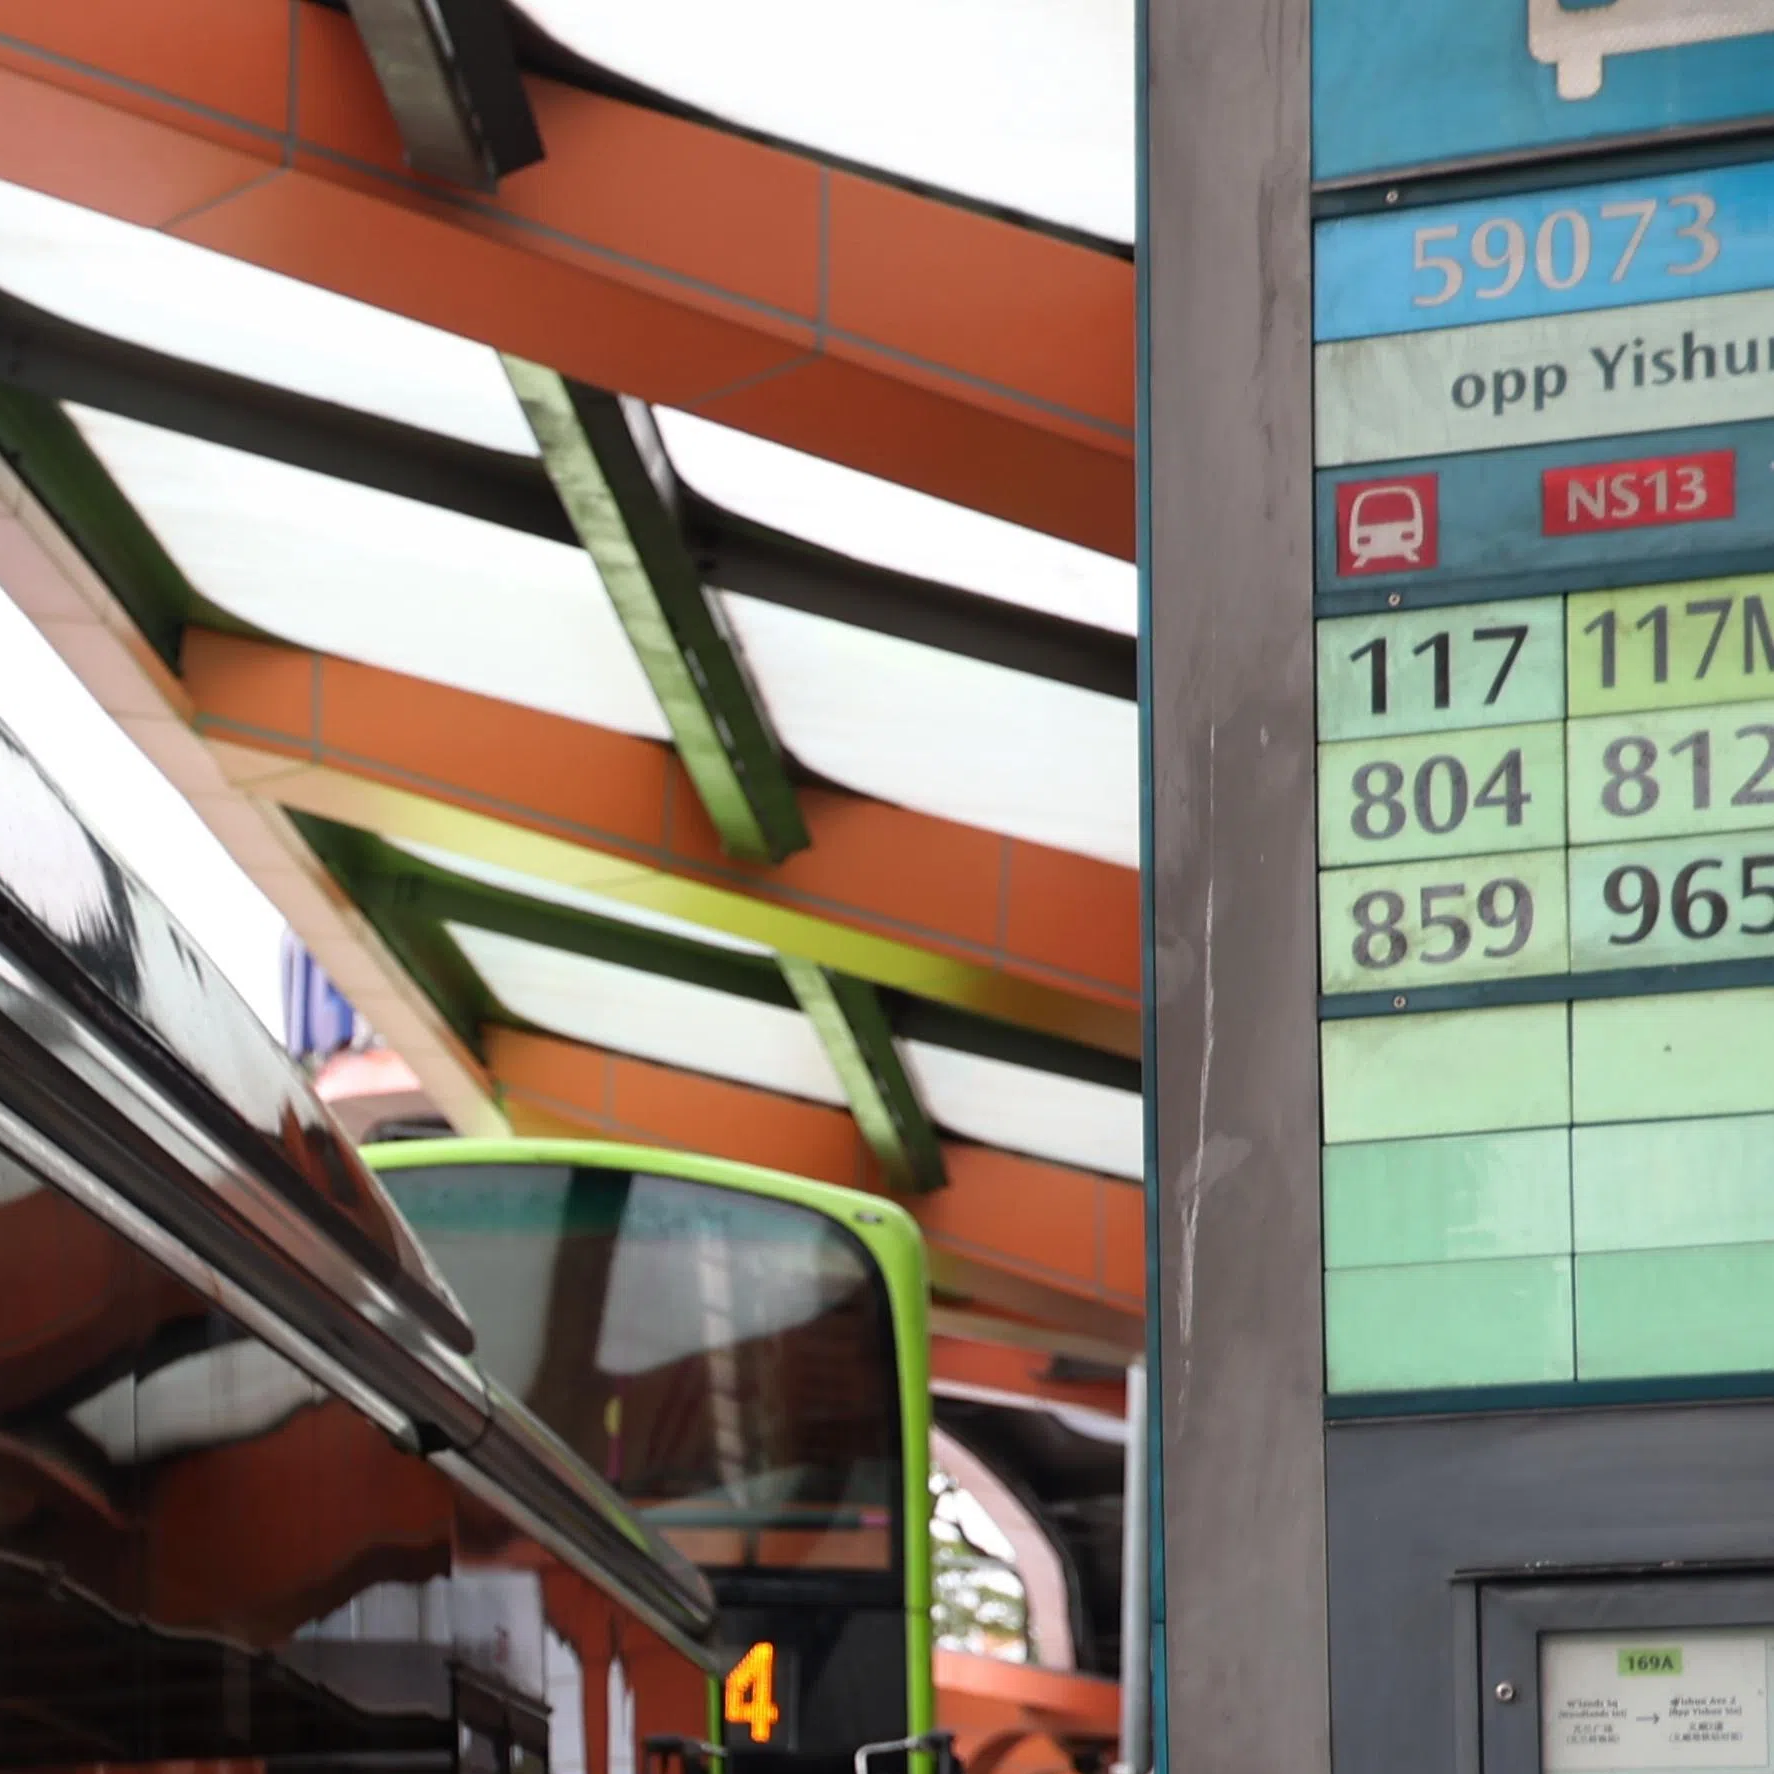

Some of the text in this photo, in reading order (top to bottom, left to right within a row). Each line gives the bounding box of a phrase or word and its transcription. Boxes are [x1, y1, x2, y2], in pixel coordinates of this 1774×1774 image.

[1412, 194, 1720, 308] 59073
[1452, 330, 1774, 416] opp Yishu
[1566, 466, 1708, 524] NS13
[1349, 624, 1530, 715] 117
[1350, 748, 1532, 841] 804
[1601, 723, 1774, 818] 812
[1351, 877, 1534, 970] 859
[1603, 853, 1774, 945] 965
[725, 1641, 779, 1743] 4
